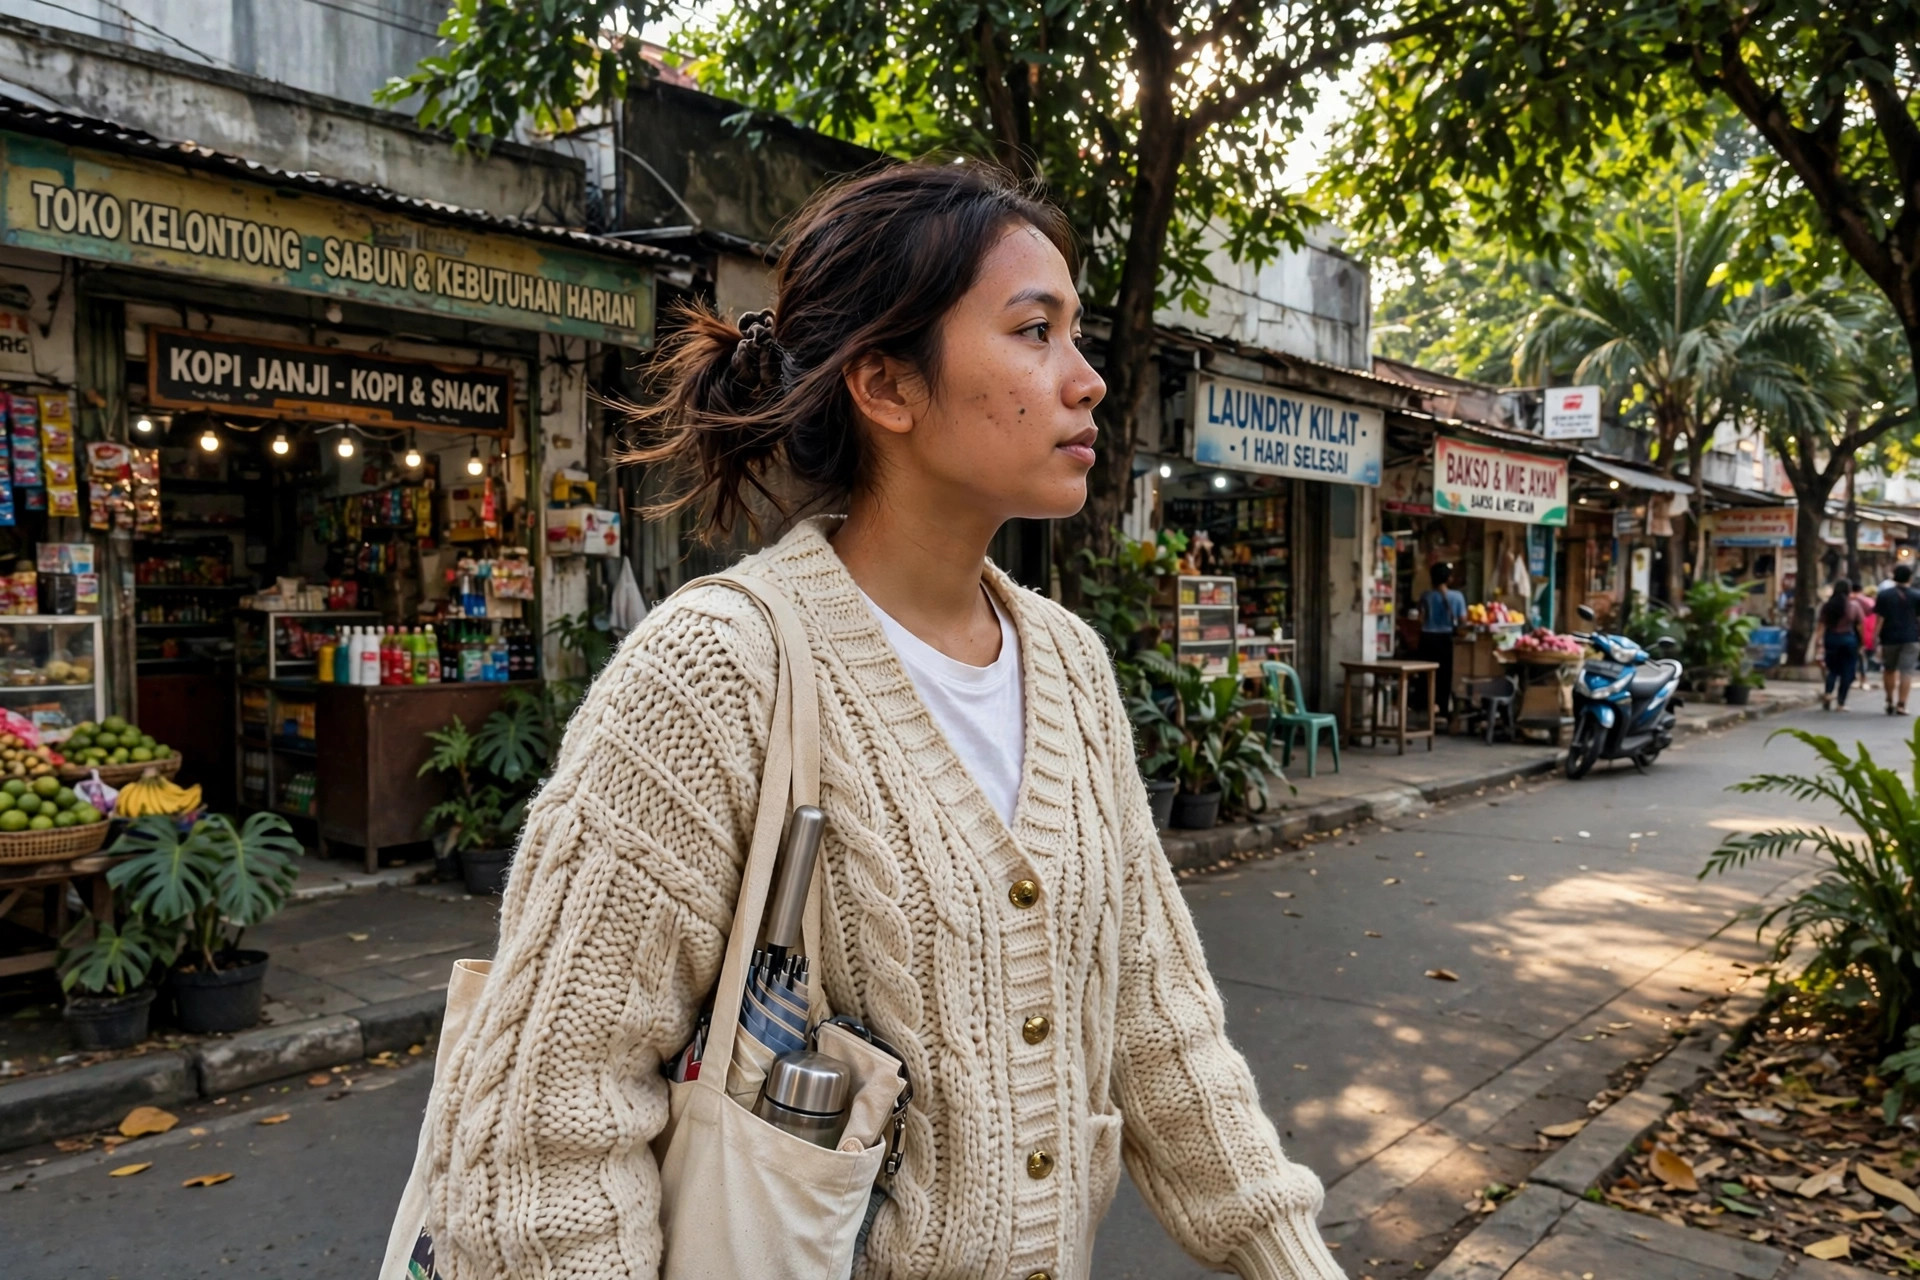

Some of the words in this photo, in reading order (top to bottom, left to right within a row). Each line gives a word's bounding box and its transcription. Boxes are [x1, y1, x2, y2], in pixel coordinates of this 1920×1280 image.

[31, 181, 122, 240] TOKO
[130, 199, 301, 271] KELONTONG
[323, 236, 406, 289] SABUN
[413, 253, 431, 292] &
[436, 257, 562, 316] KEBUTUHAN
[567, 283, 636, 328] HARIAN
[170, 347, 241, 387] KOPI
[250, 357, 329, 396] JANJI
[351, 369, 404, 405] KOPI
[410, 376, 425, 406] &
[431, 377, 500, 414] SNACK
[1208, 384, 1304, 438] LAUNDRY
[1309, 403, 1360, 446] KILAT
[1242, 436, 1248, 461] 1
[1254, 437, 1289, 466] HARI
[1293, 444, 1348, 475] SELESAI
[1446, 452, 1490, 489] BAKSO
[1493, 461, 1501, 491] &
[1505, 463, 1525, 495] MIE
[1528, 468, 1557, 500] AYAM
